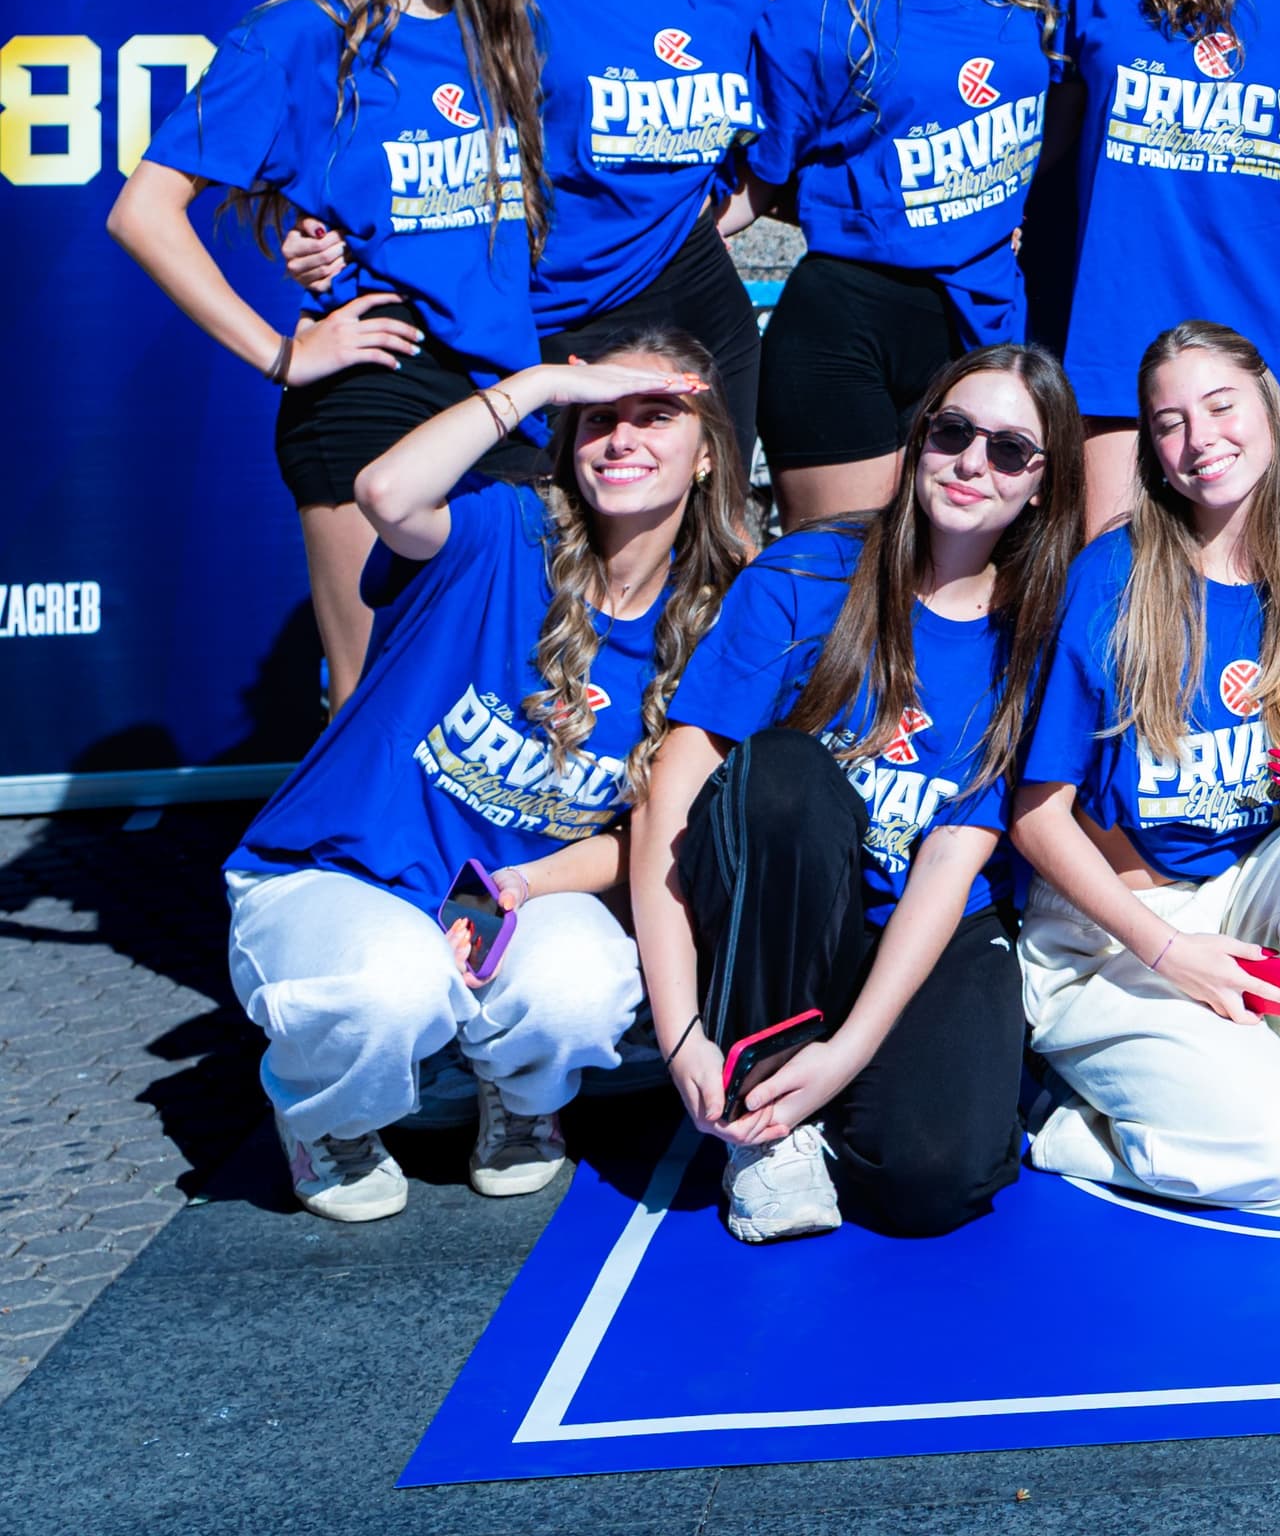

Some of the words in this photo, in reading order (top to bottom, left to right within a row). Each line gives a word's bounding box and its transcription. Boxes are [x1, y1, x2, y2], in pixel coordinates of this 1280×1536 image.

[635, 115, 737, 161] Hrvatsk
[1106, 140, 1133, 164] WE
[1137, 149, 1205, 173] PROVED
[1144, 118, 1256, 155] Hrvatske
[905, 206, 938, 228] WE
[938, 184, 1005, 222] PROVED
